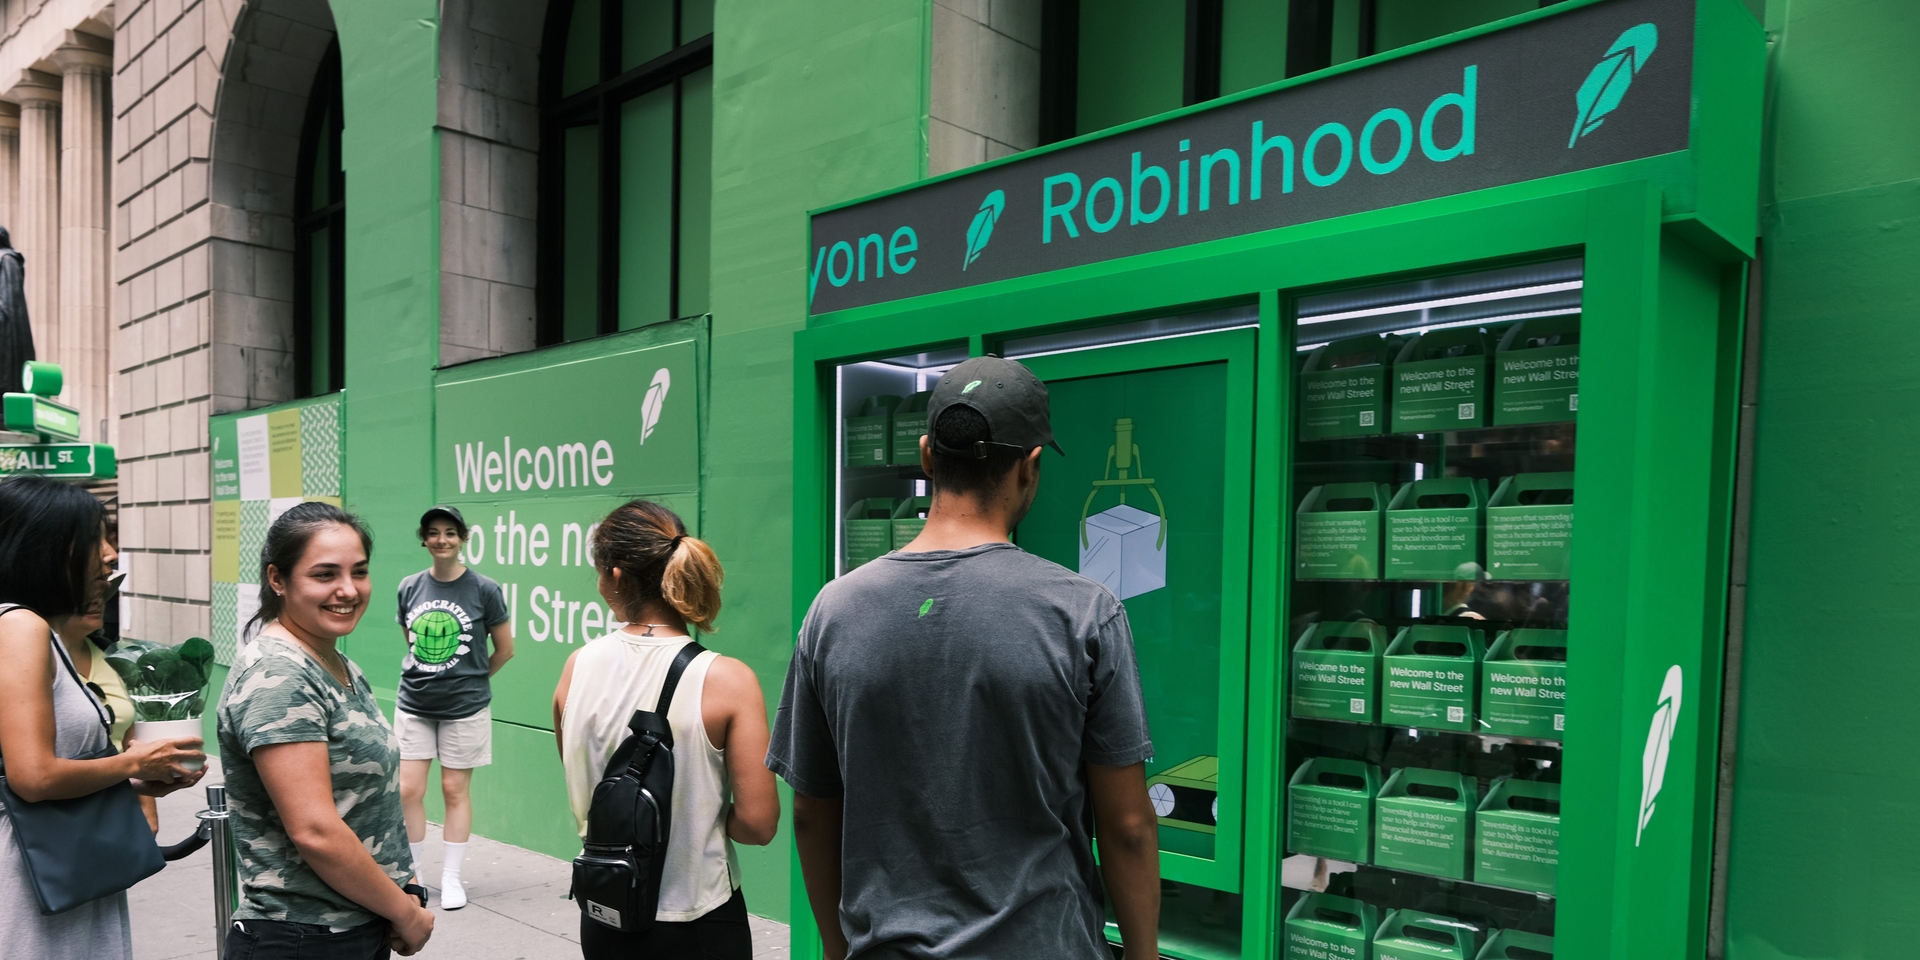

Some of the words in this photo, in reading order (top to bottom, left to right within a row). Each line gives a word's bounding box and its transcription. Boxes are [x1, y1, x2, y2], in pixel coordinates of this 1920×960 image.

[1042, 64, 1478, 244] Robinhood
[1504, 360, 1553, 371] Welcome
[1556, 358, 1567, 366] to
[1401, 371, 1444, 381] Welcome
[1446, 369, 1456, 377] to
[1458, 367, 1475, 376] the
[1503, 376, 1526, 384] new
[1528, 371, 1551, 382] Wall
[1307, 380, 1347, 389] Welcome
[1360, 377, 1375, 385] the
[1422, 382, 1442, 391] Wall
[1444, 380, 1474, 390] Street
[1327, 390, 1345, 400] Wall
[1347, 389, 1374, 398] Street
[8, 450, 57, 470] ALL
[455, 436, 614, 493] Welcome
[458, 524, 484, 565] o
[495, 510, 549, 566] the
[1299, 662, 1338, 672] Welcome
[1339, 664, 1348, 672] to
[1350, 665, 1365, 674] the
[1390, 667, 1433, 678] Welcome
[1436, 671, 1445, 679] to
[1447, 671, 1464, 680] the
[1318, 674, 1336, 683] Wall
[1338, 676, 1364, 685] Street
[1490, 673, 1538, 684] Welcome
[1540, 676, 1552, 685] to
[1554, 677, 1565, 686] th
[1412, 681, 1431, 690] Wall
[1433, 682, 1463, 693] Street
[1490, 687, 1512, 695] new
[1514, 687, 1536, 697] Wall
[1539, 689, 1566, 699] Stree
[1403, 818, 1418, 827] help
[1419, 821, 1445, 830] achieve
[1382, 824, 1409, 833] financial
[1411, 828, 1439, 838] freedom
[1393, 834, 1425, 845] American
[1507, 832, 1522, 842] help
[1524, 836, 1553, 845] achieve
[1482, 838, 1513, 849] financial
[1515, 843, 1546, 854] freedom
[1496, 850, 1531, 861] American
[592, 905, 603, 916] R
[1290, 933, 1328, 949] Welcome
[1330, 943, 1339, 951] to
[1341, 945, 1355, 955] the
[1290, 946, 1307, 955] new
[1309, 949, 1326, 959] Wall
